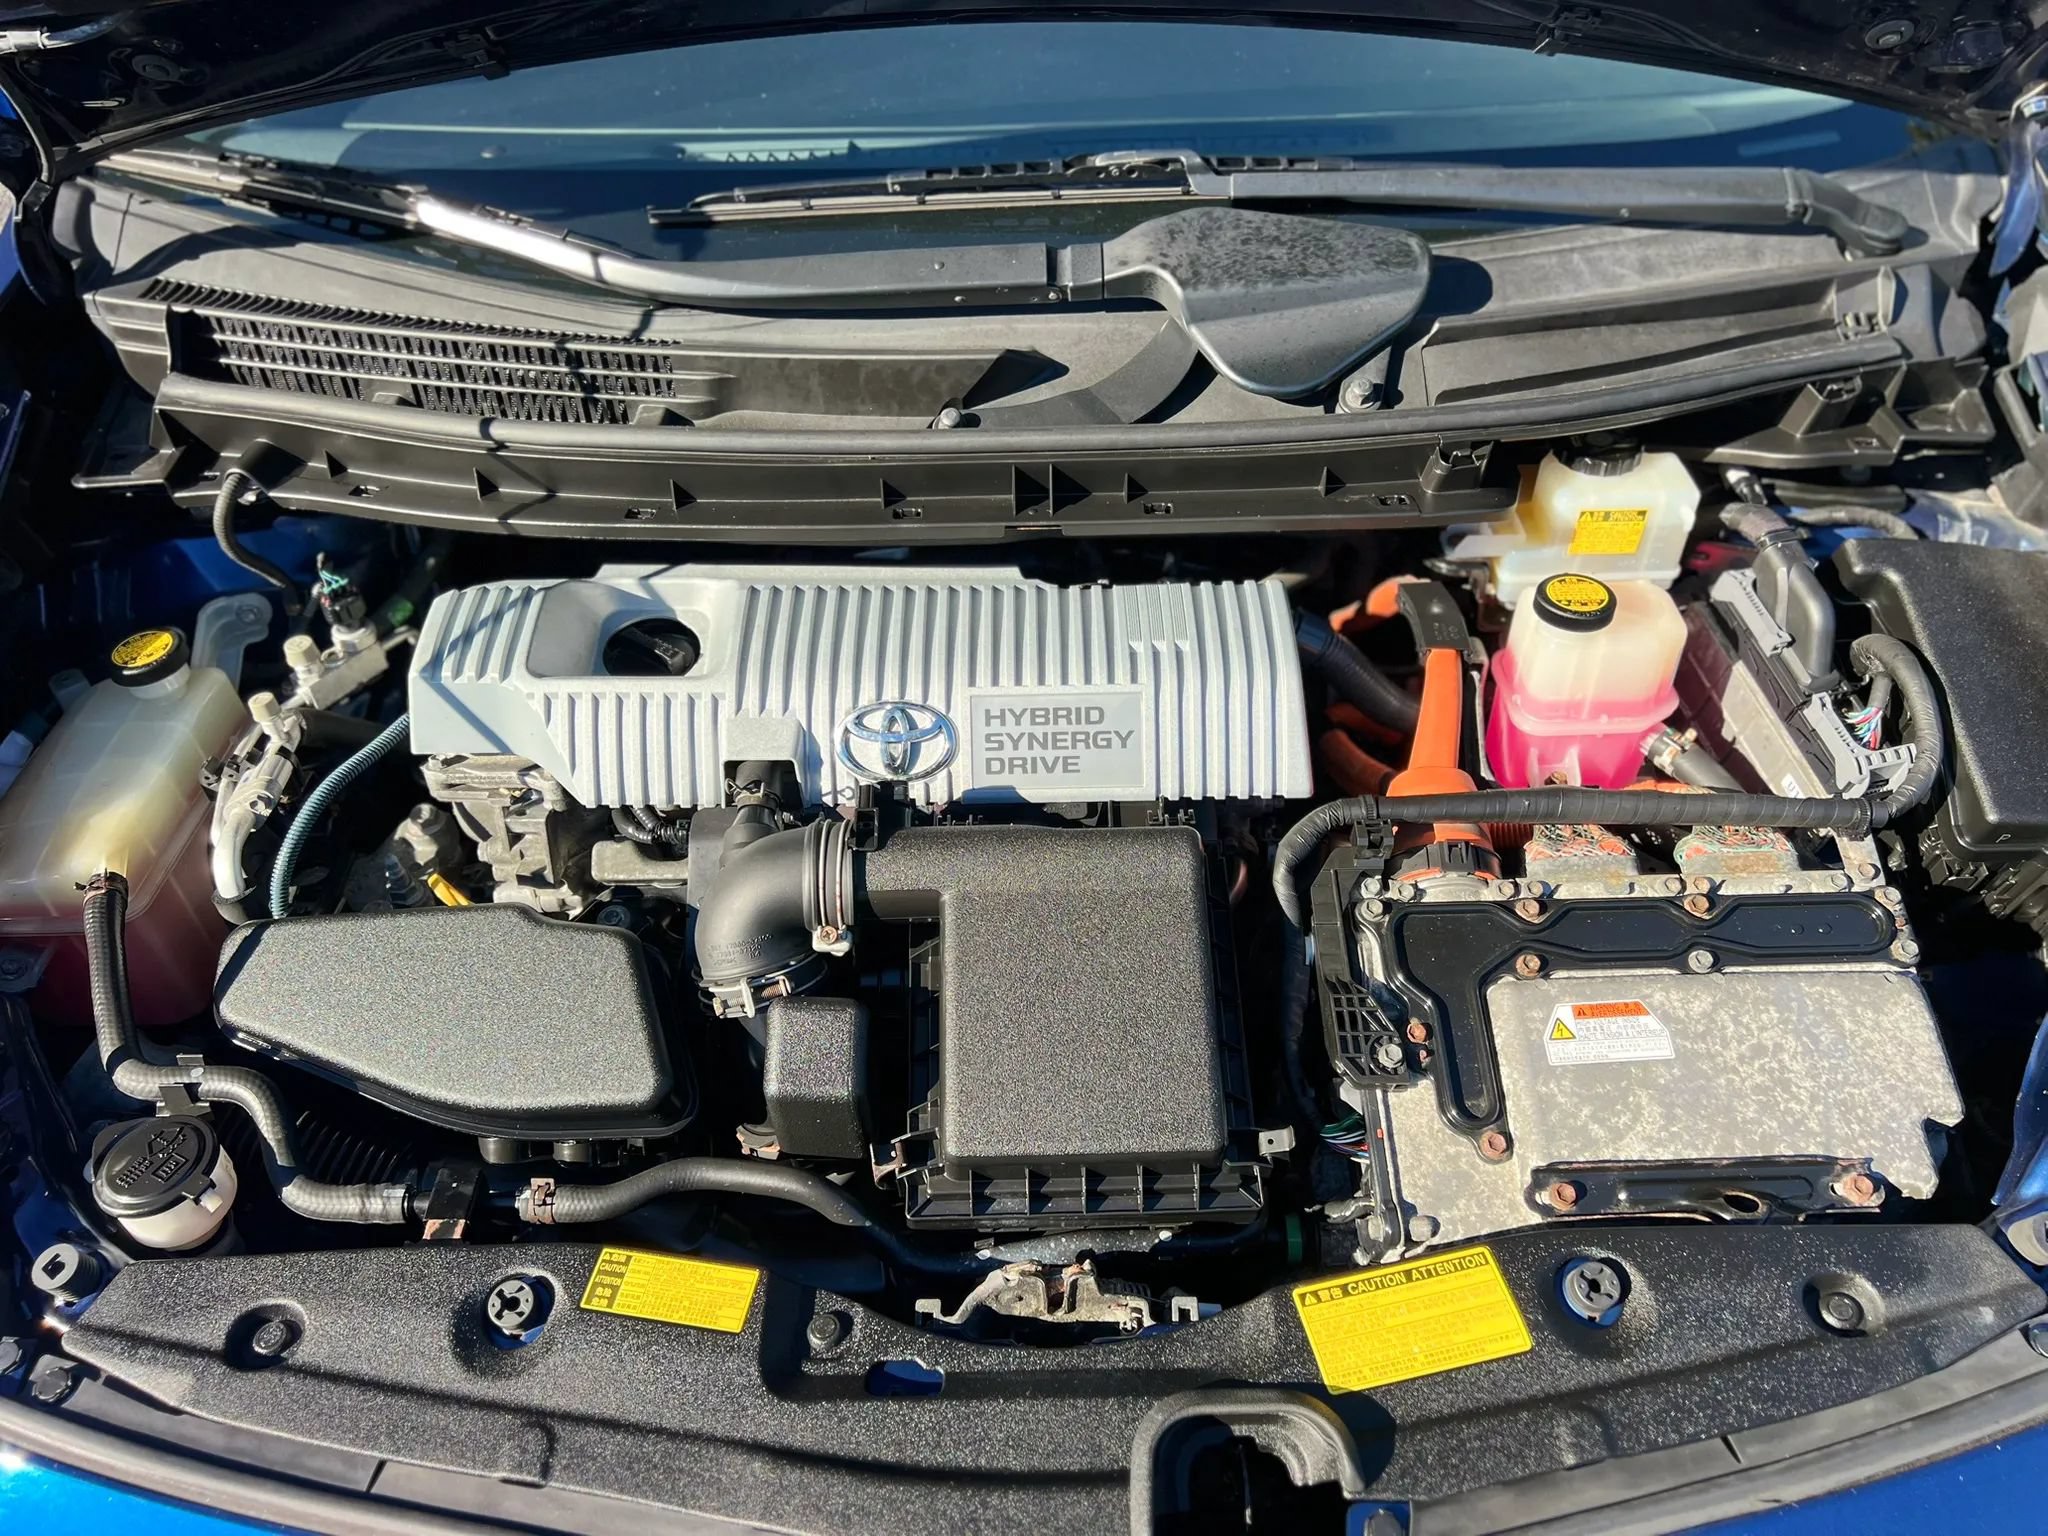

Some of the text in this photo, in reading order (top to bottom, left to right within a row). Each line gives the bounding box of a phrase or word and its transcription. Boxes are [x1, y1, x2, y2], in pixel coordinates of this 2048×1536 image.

[984, 706, 1105, 727] HYBRID
[984, 730, 1135, 752] SYNERGY
[985, 755, 1081, 775] DRIVE
[599, 1262, 627, 1274] CAUTION
[594, 1275, 622, 1287] ATTENTION
[1317, 1254, 1486, 1303] 警告 CAUTION ATTENTION
